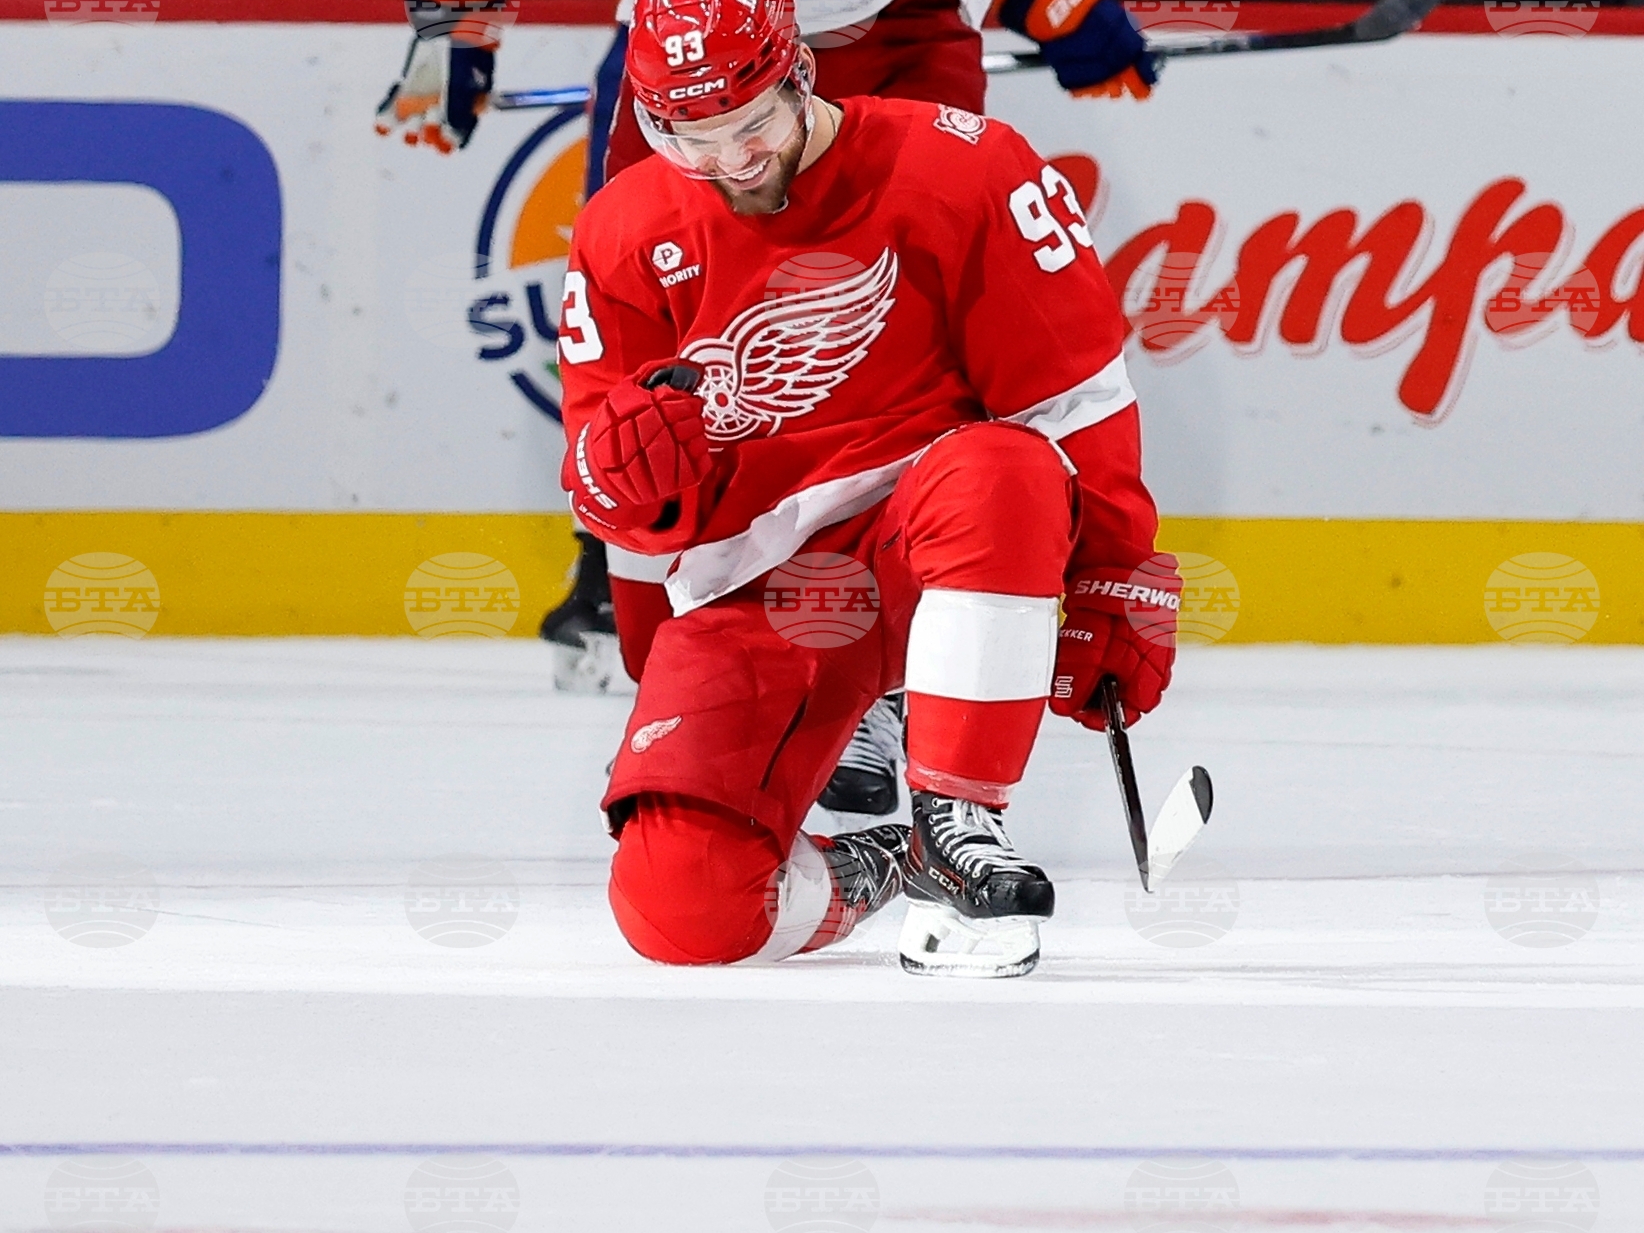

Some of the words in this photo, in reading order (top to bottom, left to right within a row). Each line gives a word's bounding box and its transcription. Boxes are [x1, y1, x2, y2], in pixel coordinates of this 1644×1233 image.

[664, 30, 705, 67] 93
[669, 78, 726, 100] CCM
[1008, 164, 1094, 274] 93
[1048, 153, 1644, 425] ampa
[557, 271, 604, 364] 3
[1075, 580, 1180, 610] SHERWO
[928, 867, 960, 895] CCM
